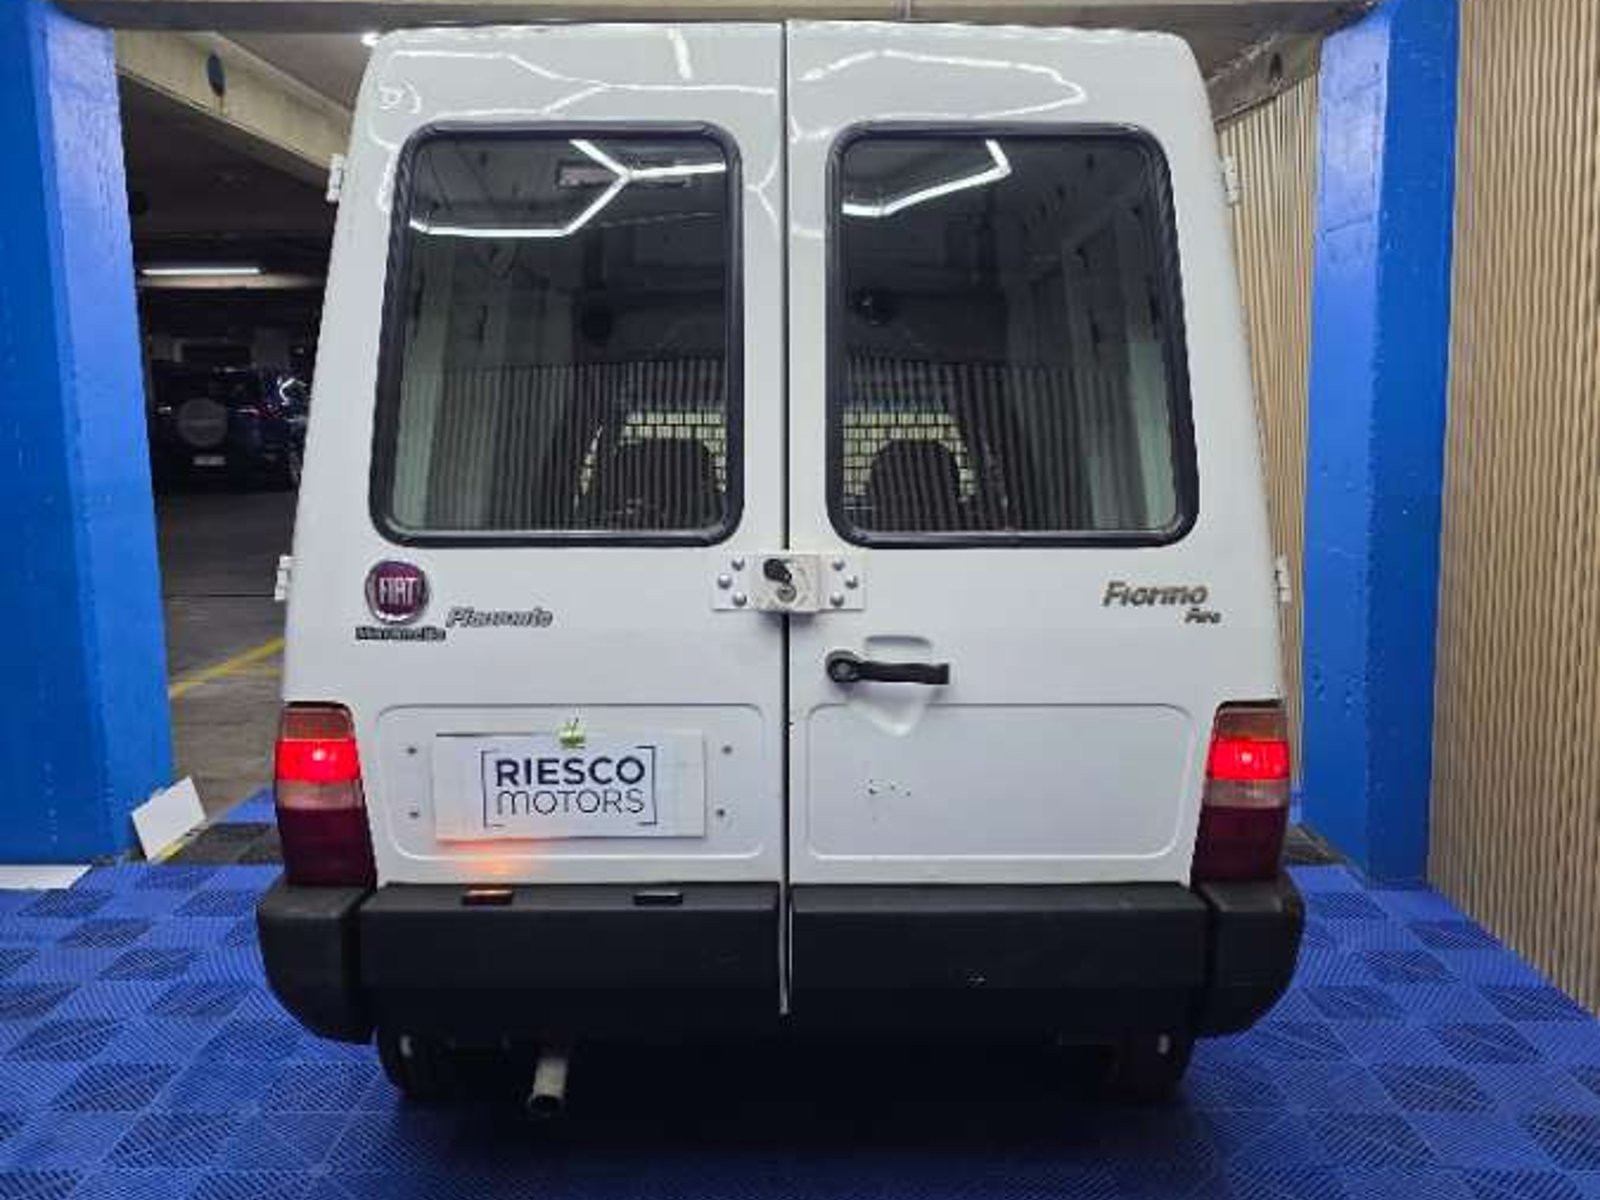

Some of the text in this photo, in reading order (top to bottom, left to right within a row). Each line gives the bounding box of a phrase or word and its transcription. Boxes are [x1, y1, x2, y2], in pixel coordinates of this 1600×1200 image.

[379, 577, 417, 605] FIAT
[1102, 580, 1208, 606] Fiorino
[495, 756, 645, 786] RIESCO
[497, 788, 645, 815] MOTORS
